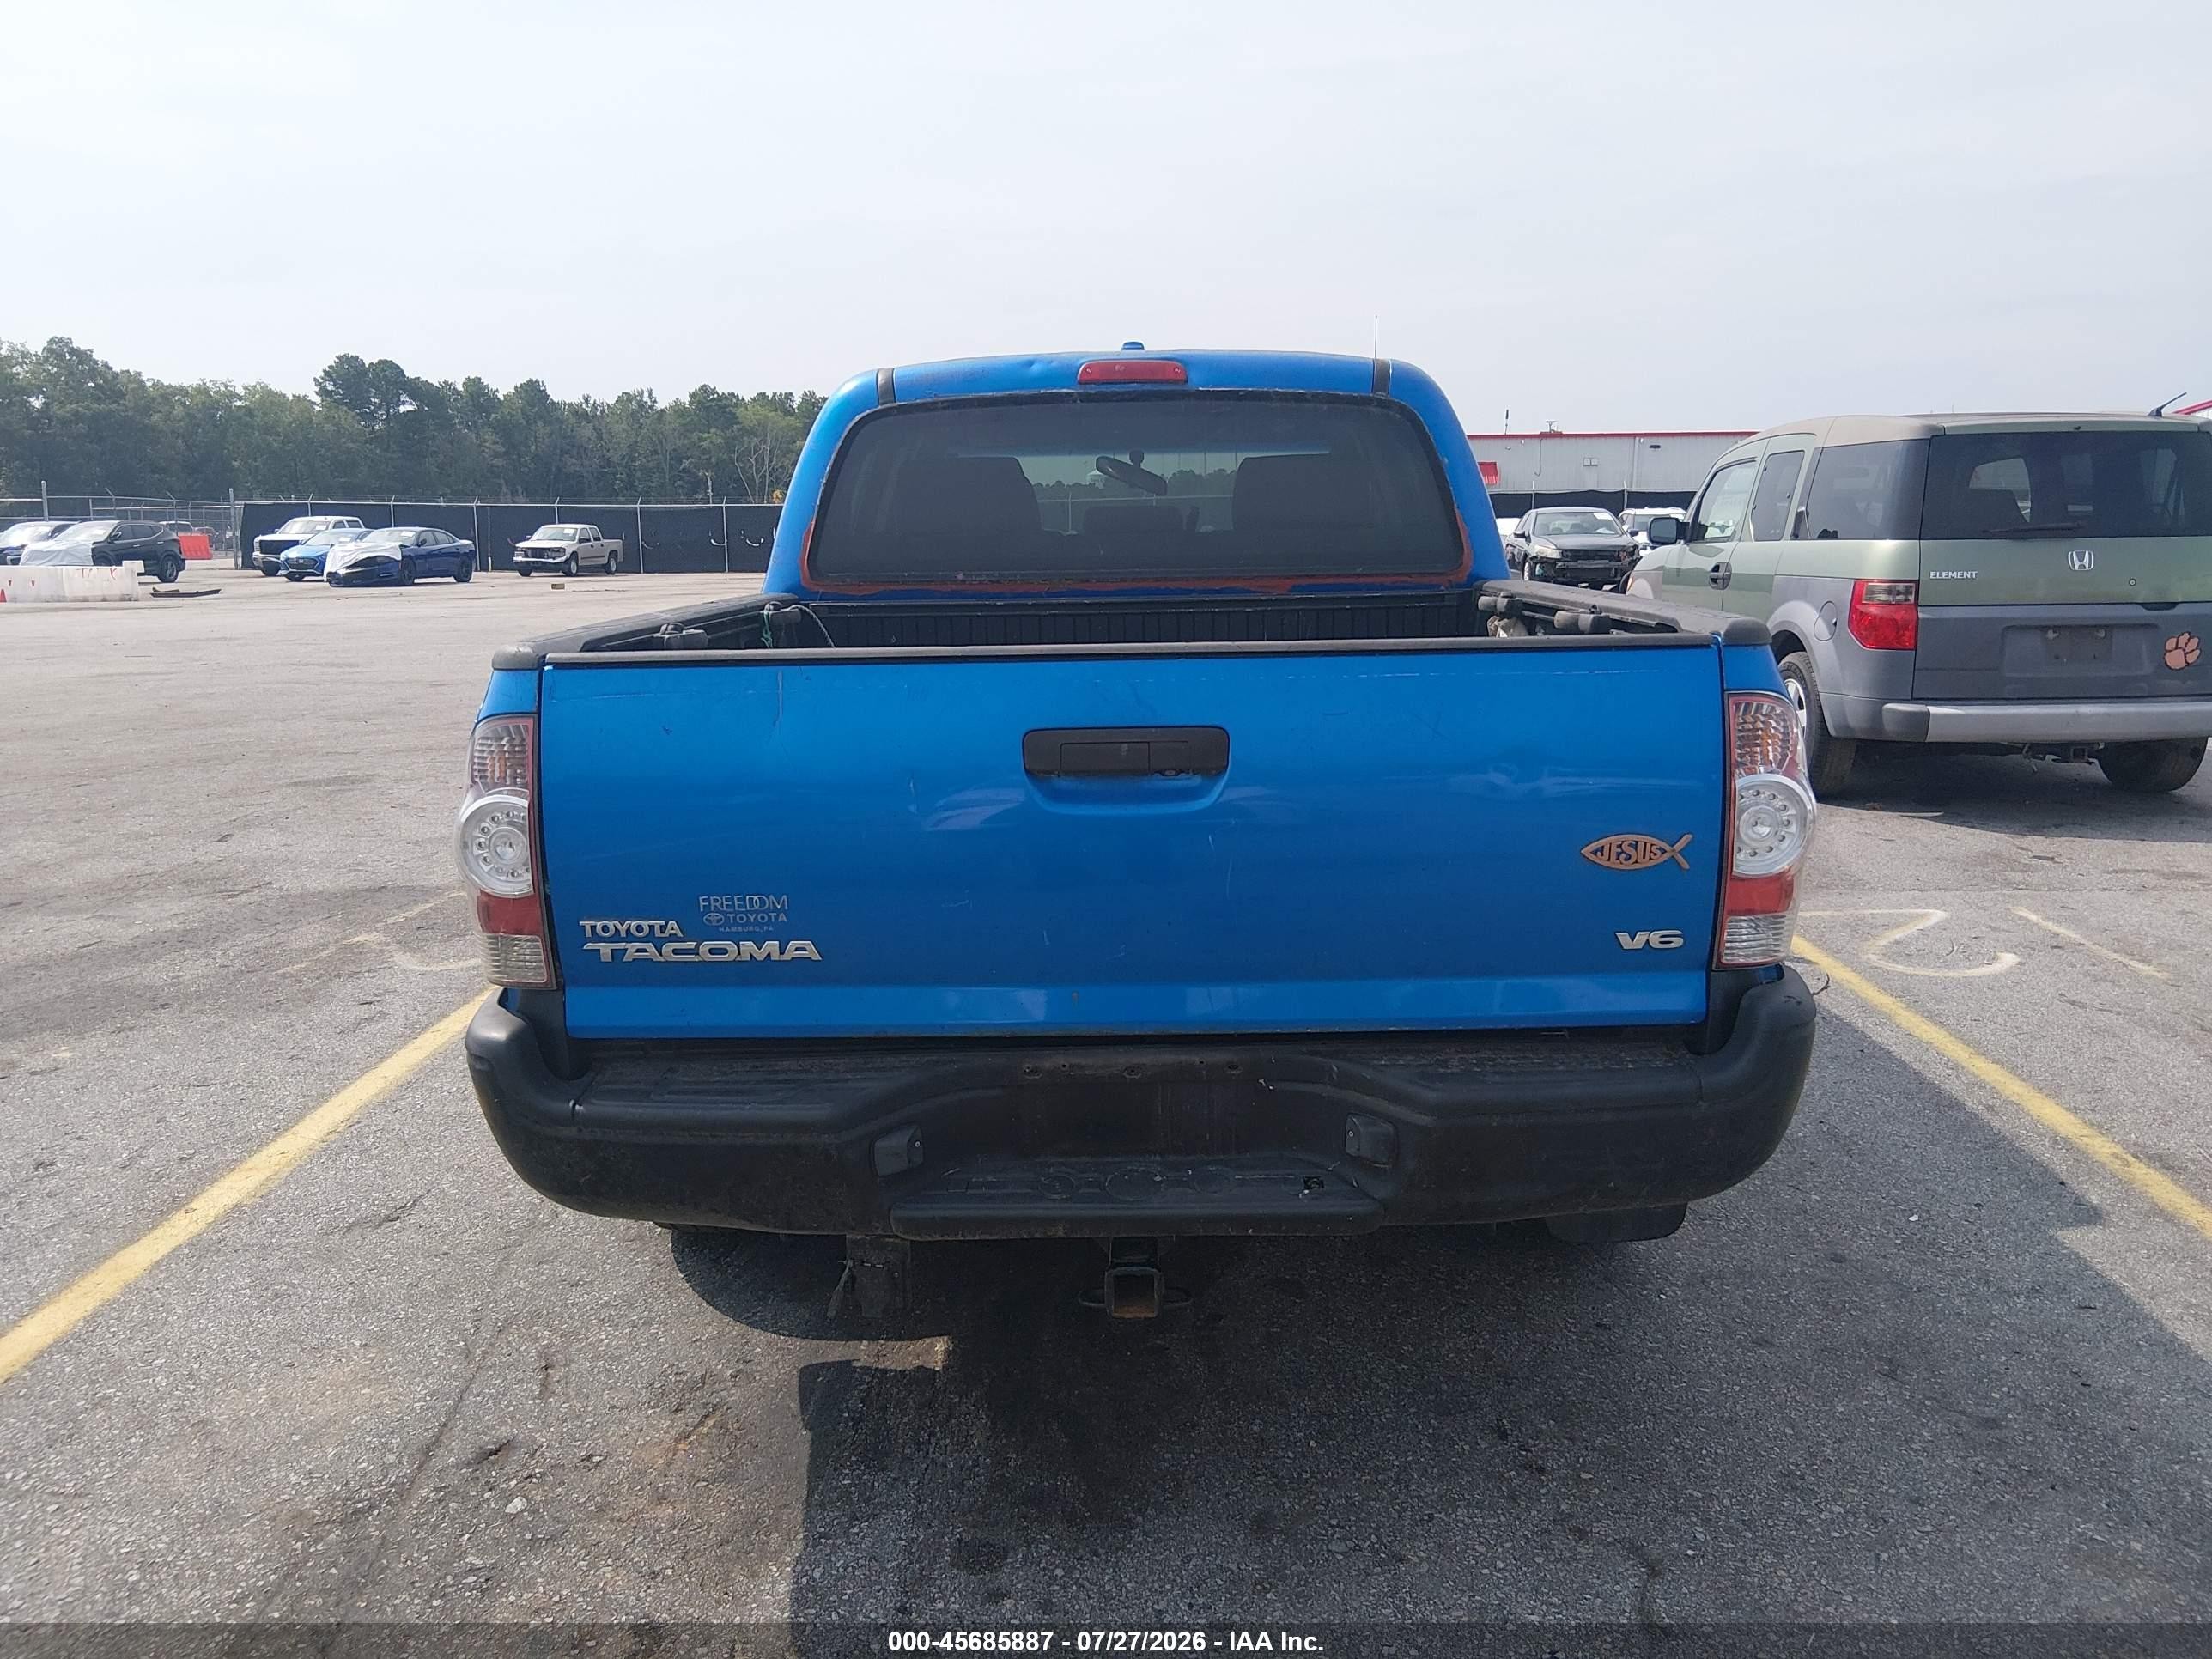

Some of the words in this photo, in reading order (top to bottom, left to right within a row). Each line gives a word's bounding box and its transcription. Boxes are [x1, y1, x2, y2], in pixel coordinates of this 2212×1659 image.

[1929, 570, 1978, 580] ELEMENT
[1595, 840, 1662, 866] JESUS
[699, 894, 788, 912] FREEDOM
[726, 912, 787, 924] TOYOTA
[579, 920, 684, 938] TOYOTA
[1615, 930, 1684, 951] V6
[583, 939, 823, 963] TACOMA
